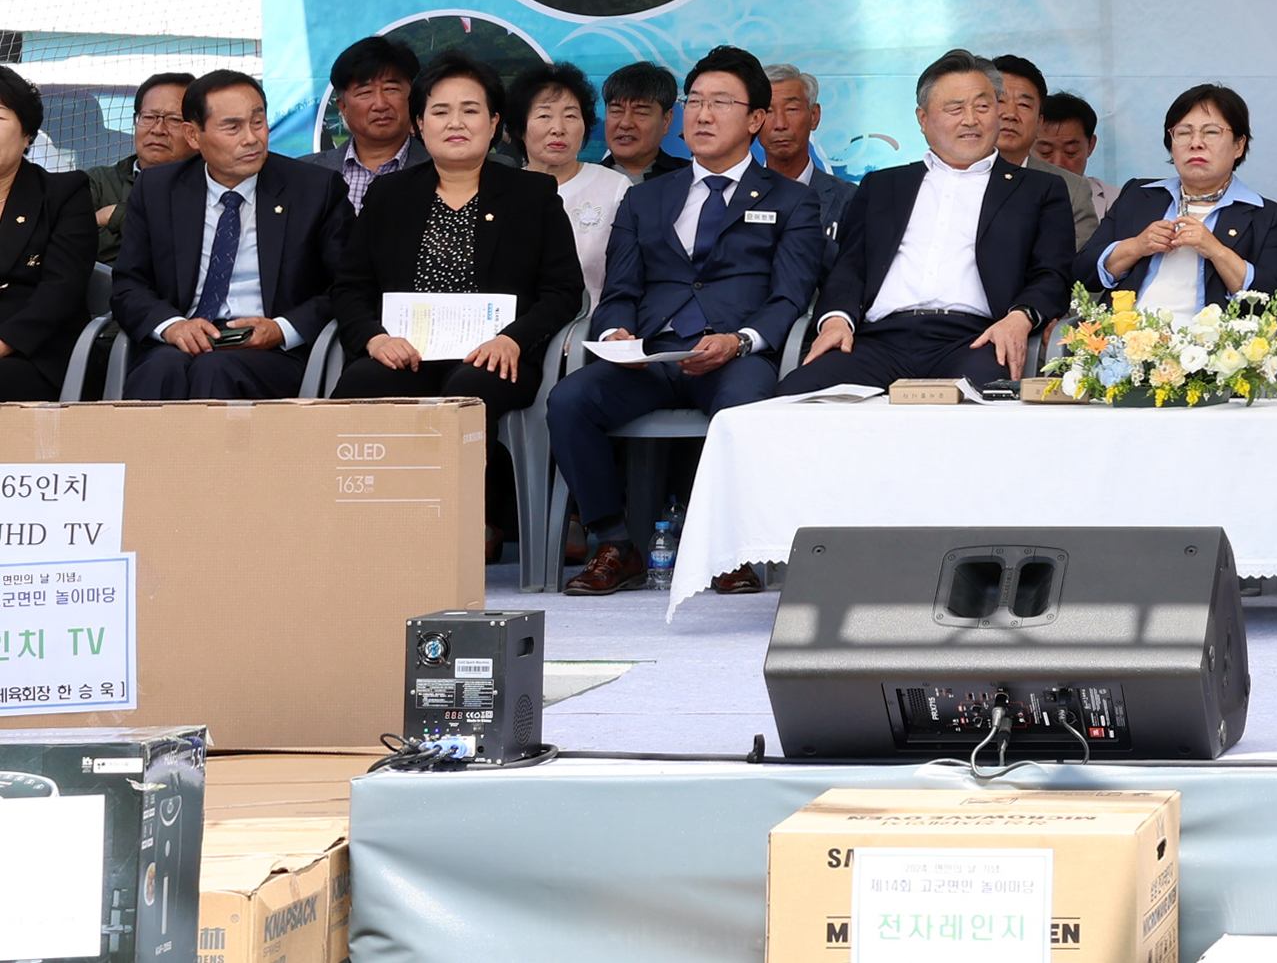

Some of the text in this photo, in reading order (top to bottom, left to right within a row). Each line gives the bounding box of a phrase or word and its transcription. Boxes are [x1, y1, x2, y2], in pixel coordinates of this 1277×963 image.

[336, 442, 386, 461] QLED
[1, 473, 88, 502] 65인치
[335, 475, 364, 494] 163
[0, 522, 104, 546] HD TV
[2, 574, 34, 586] 면민의
[39, 572, 50, 585] 날
[0, 586, 116, 608] 군면민 놀이마당
[67, 626, 105, 657] TV
[57, 684, 72, 701] 한
[78, 682, 93, 699] 승
[100, 681, 115, 697] 욱
[870, 878, 1035, 895] 제14회 고군면민 놀이마당
[263, 894, 319, 944] KNAPSACK
[876, 912, 1026, 942] 전자레인지
